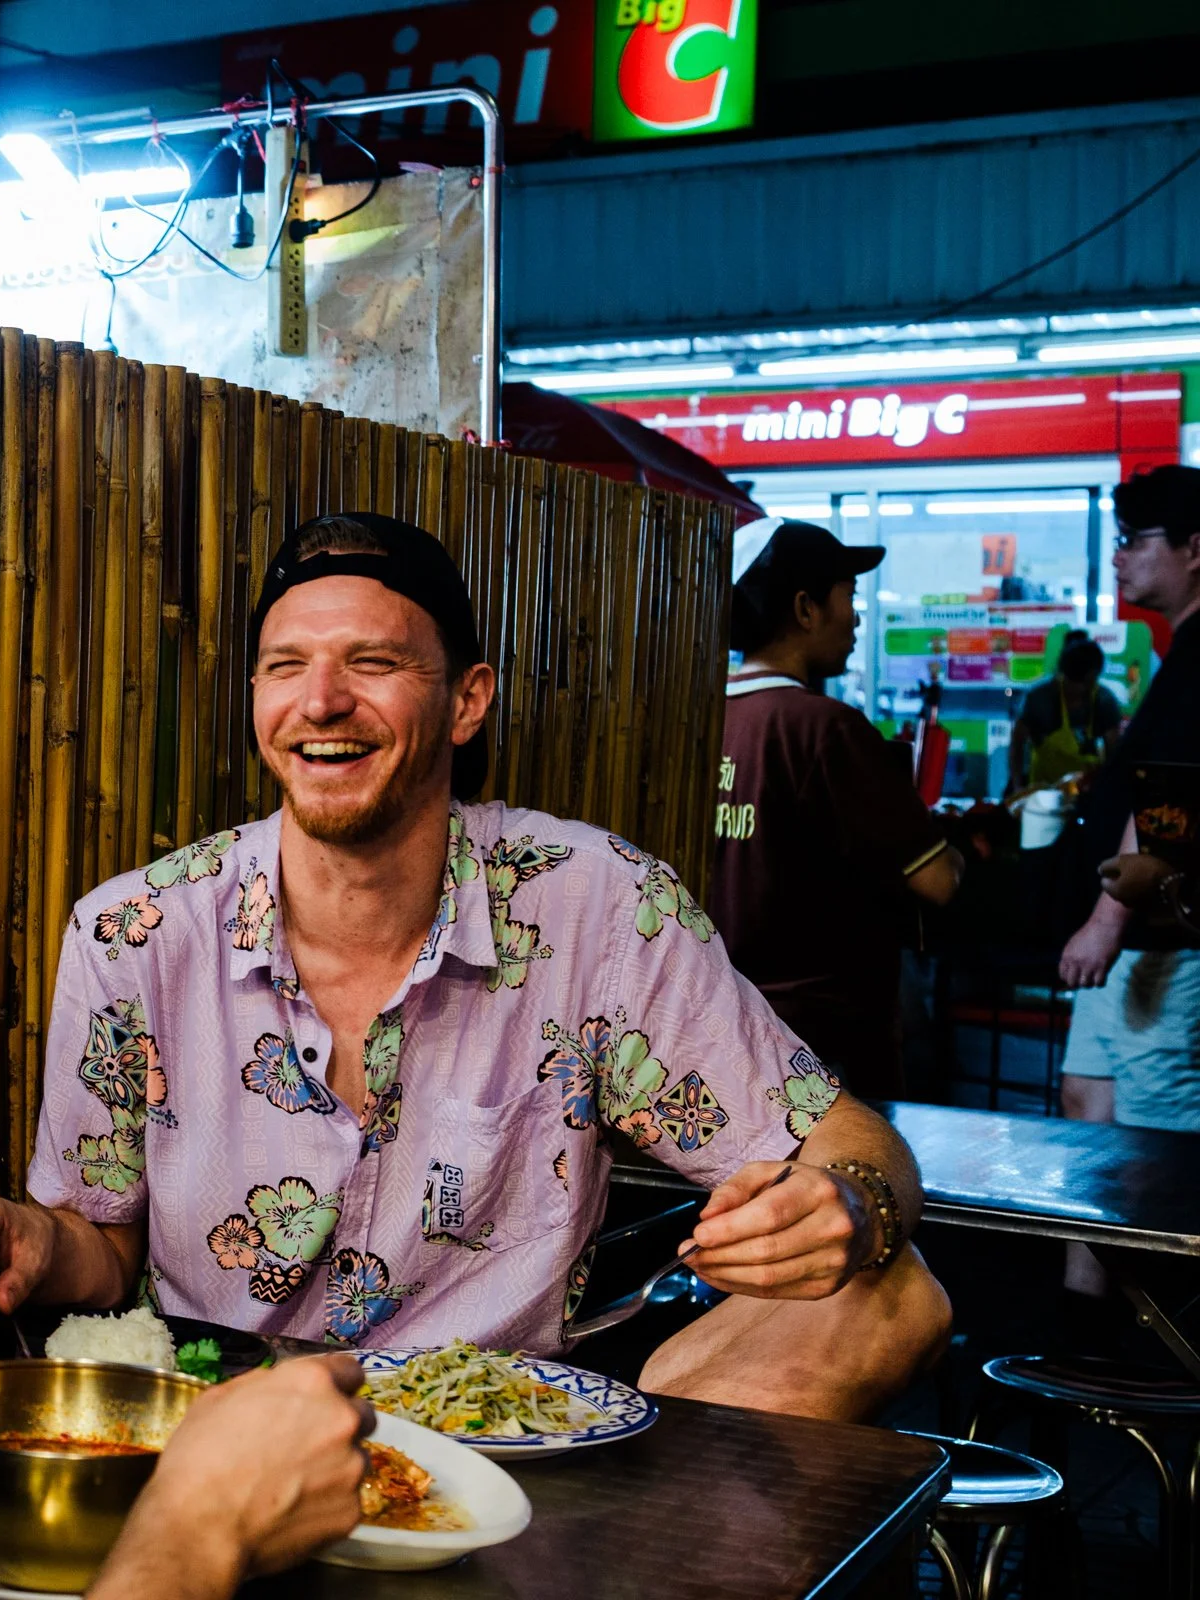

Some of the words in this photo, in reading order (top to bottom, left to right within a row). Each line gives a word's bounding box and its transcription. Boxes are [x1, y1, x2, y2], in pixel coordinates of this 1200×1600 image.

[616, 0, 687, 33] Big
[618, 0, 742, 131] C
[742, 401, 846, 442] mini
[848, 394, 929, 447] Big
[934, 394, 969, 434] C
[715, 803, 755, 840] RUB
